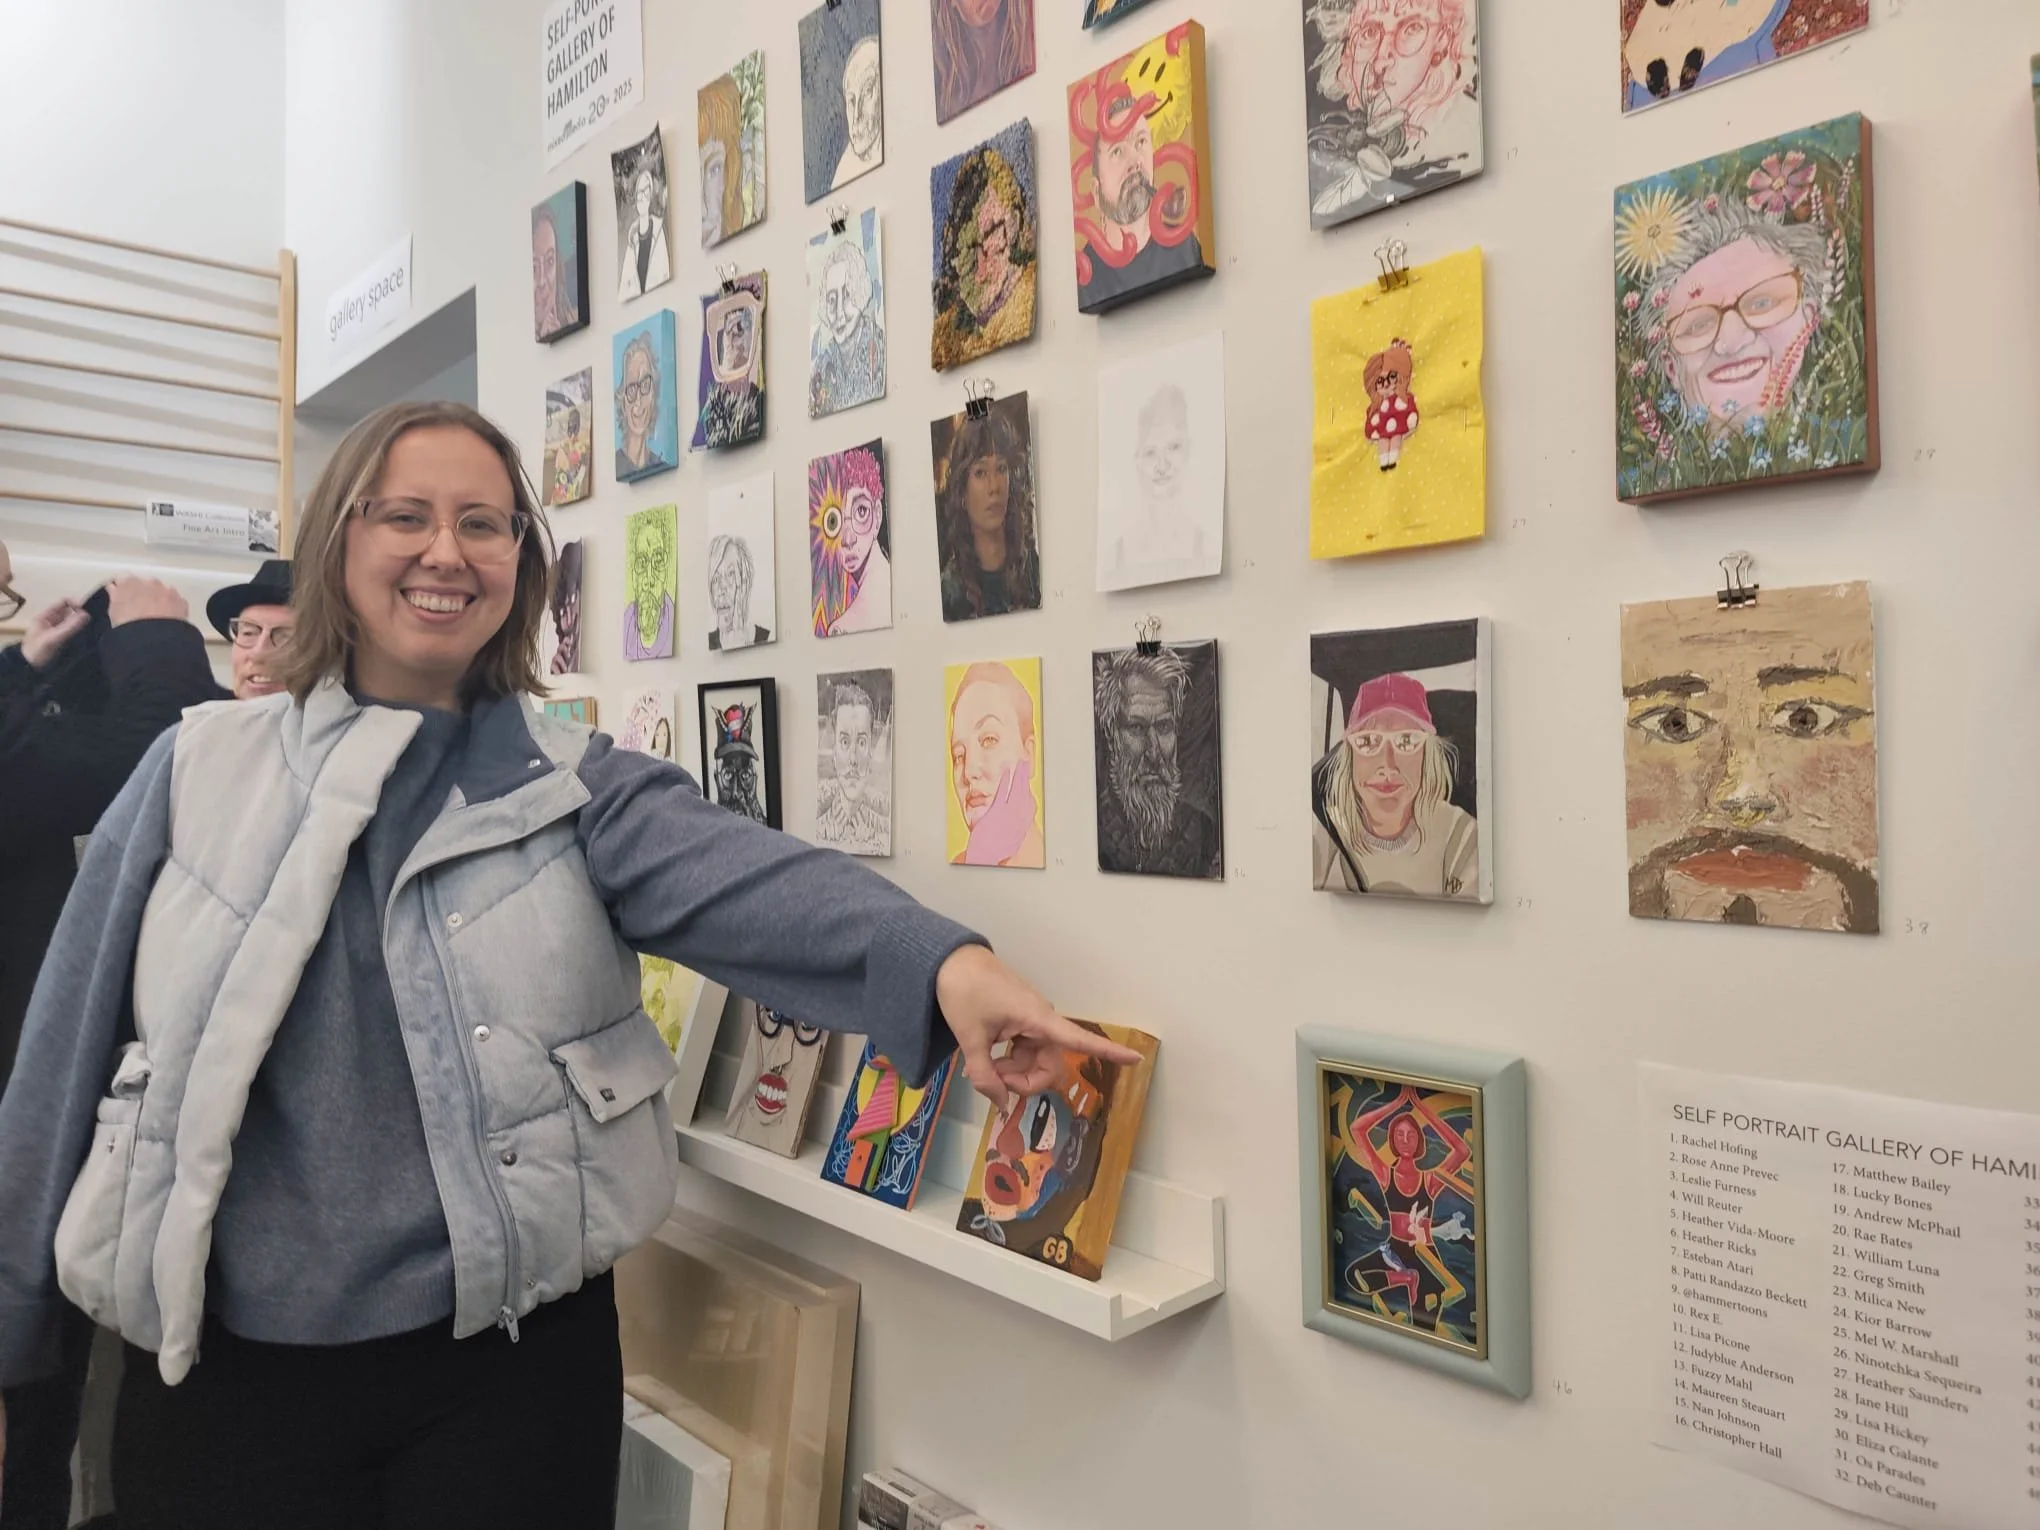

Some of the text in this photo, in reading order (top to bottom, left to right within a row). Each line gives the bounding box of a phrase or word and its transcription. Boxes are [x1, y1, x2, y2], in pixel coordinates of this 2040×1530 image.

[547, 4, 615, 84] GALLERY OF
[547, 48, 608, 120] HAMILTON
[614, 77, 633, 104] 2025
[330, 267, 404, 342] gallery space
[1671, 1133, 1758, 1160] 1. Rachel Hofing
[1673, 1104, 2040, 1181] SELF PORTRAIT GALLERY OF HAMI
[1670, 1151, 1779, 1181] 2. Rose Anne Prevec
[1833, 1162, 1952, 1196] 17. Matthew Bailey
[1670, 1171, 1757, 1197] 3. Leslie Furness
[1833, 1183, 1933, 1212] 18. Lucky Bones
[1670, 1190, 1743, 1214] 4. Will Reuter
[1670, 1209, 1796, 1245] 5. Heather Vida-Moore
[1832, 1223, 1913, 1250] 20. Rae Bates
[1833, 1203, 1961, 1239] 19. Andrew McPhail
[1670, 1228, 1757, 1257] 6. Heather Ricks
[1671, 1246, 1754, 1276] 7. Esteban Atari
[1832, 1244, 1940, 1278] 21. William Luna
[1671, 1265, 1808, 1309] 8. Patti Randazzo Beckett
[1832, 1265, 1926, 1296] 22. Greg Smith
[1671, 1284, 1768, 1319] 9. @hammertoons
[1673, 1303, 1723, 1325] 10. Rex E.
[1832, 1285, 1926, 1316] 23. Milica New
[1673, 1322, 1751, 1352] 11. Lisa Picone
[1832, 1306, 1933, 1339] 24. Kior Barrow
[1673, 1340, 1795, 1385] 12. Judyblue Anderson
[1832, 1326, 1960, 1368] 25. Mel W. Marshall
[1674, 1359, 1753, 1392] 13. Fuzzy Mahl
[1833, 1347, 1983, 1396] 26. Ninotchka Sequeira
[1675, 1378, 1688, 1390] 14.
[1691, 1382, 1738, 1406] Maureen
[1833, 1367, 1969, 1414] 27. Heather Saunders
[1833, 1387, 1909, 1419] 28. Jane Hill
[1675, 1396, 1760, 1432] 15. Nan Johnson
[1834, 1408, 1929, 1447] 29. Lisa Hickey
[1675, 1415, 1782, 1459] 16. Christopher Hall
[1834, 1428, 1940, 1470] 30. Eliza Galante
[1835, 1448, 1852, 1463] 31.
[1855, 1454, 1873, 1470] Os
[1835, 1468, 1852, 1483] 32.
[1856, 1474, 1882, 1493] Deb
